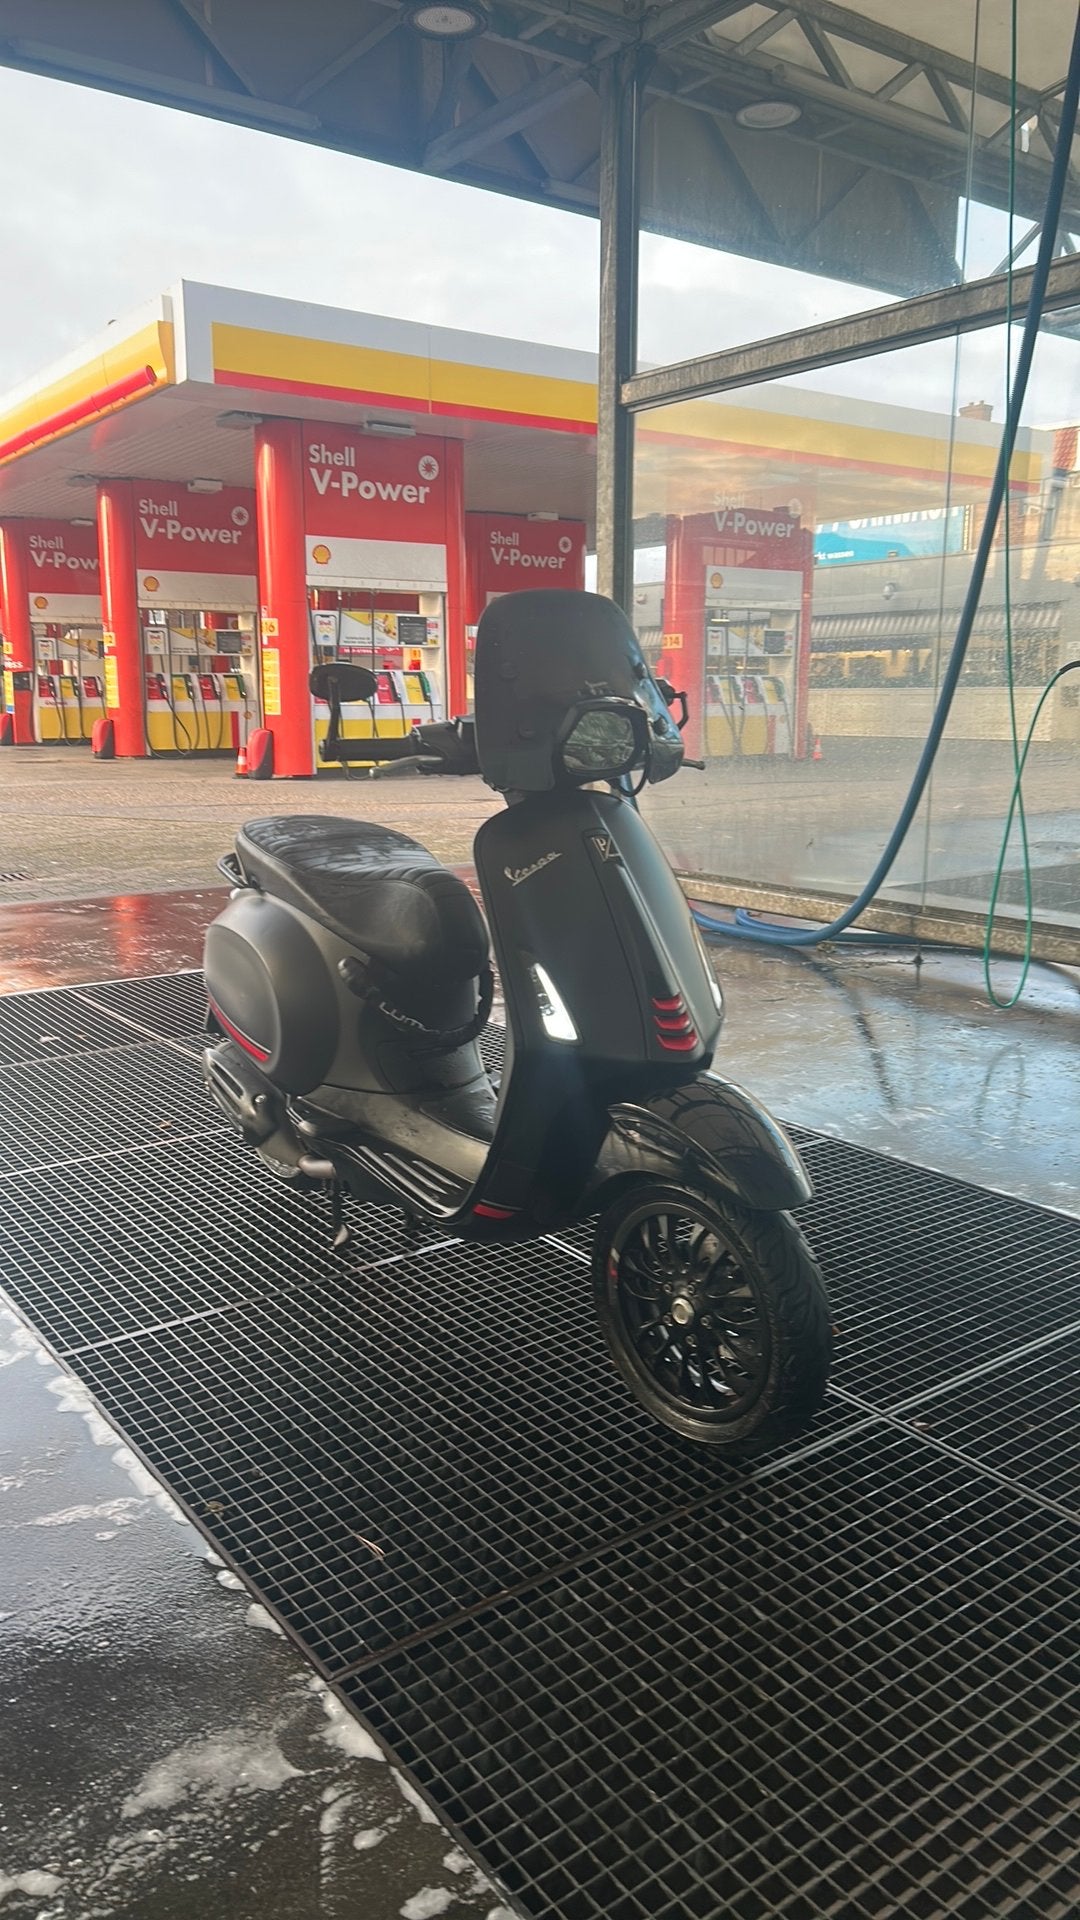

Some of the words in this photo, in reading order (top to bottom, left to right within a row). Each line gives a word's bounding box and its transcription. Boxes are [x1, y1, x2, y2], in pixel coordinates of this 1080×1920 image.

[308, 443, 356, 468] Shell
[308, 467, 432, 504] V-Power
[138, 498, 179, 518] Shell
[139, 517, 242, 545] V-Power
[713, 511, 795, 538] V-Power
[29, 535, 64, 550] Shell
[490, 530, 520, 547] Shell
[29, 550, 99, 571] V-Pow
[491, 546, 567, 570] V-Power
[503, 851, 563, 886] Vespa
